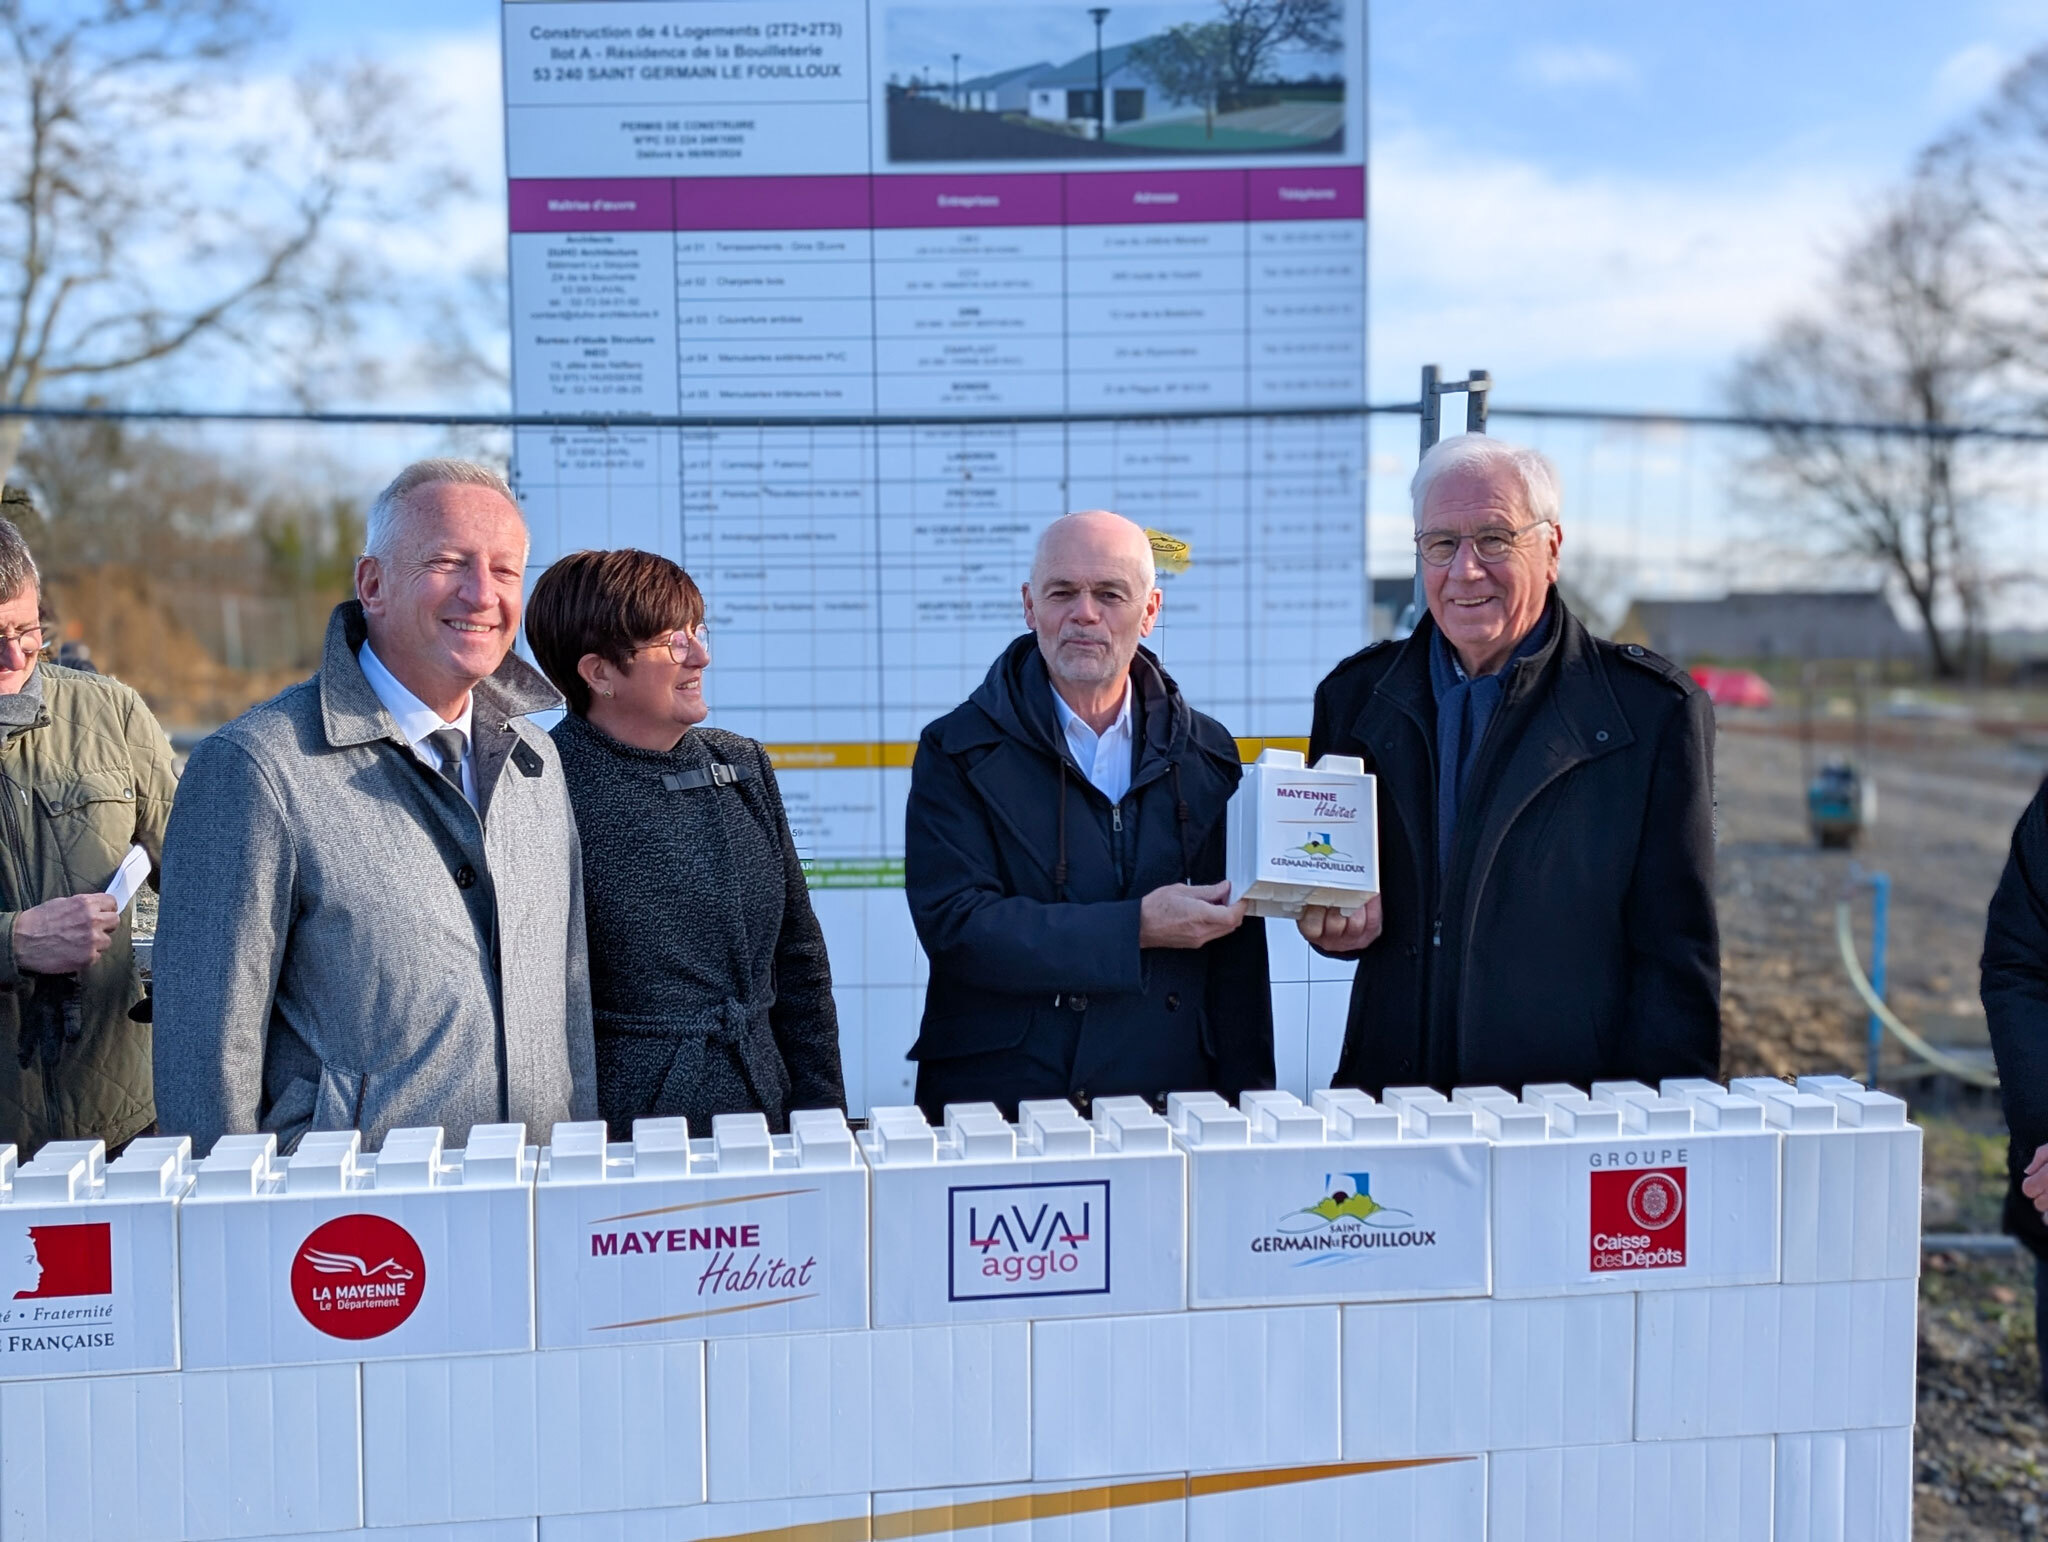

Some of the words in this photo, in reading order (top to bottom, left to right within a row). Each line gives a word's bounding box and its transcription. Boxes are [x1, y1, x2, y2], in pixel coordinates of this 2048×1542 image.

[530, 25, 633, 41] Construction
[636, 25, 655, 39] de
[659, 25, 671, 38] 4
[673, 24, 762, 42] Logements
[765, 22, 843, 39] (2T2+2T3)
[577, 46, 592, 60] A
[606, 43, 687, 60] Résidence
[691, 44, 712, 58] de
[715, 43, 730, 58] la
[734, 43, 822, 58] Bouilleterie
[533, 67, 552, 82] 53
[555, 67, 583, 82] 240
[587, 66, 636, 81] SAINT
[640, 66, 717, 80] GERMAIN
[722, 65, 743, 79] LE
[747, 64, 841, 79] FOUILLOUX
[620, 120, 662, 131] PERMIS
[666, 120, 680, 131] DE
[684, 120, 755, 131] CONSTRUIRE
[1277, 787, 1337, 802] MAYENNE
[1313, 801, 1357, 819] Habitat
[1271, 856, 1313, 869] GERMAIN
[1316, 860, 1365, 874] FOUILLOUX
[1589, 1149, 1689, 1168] GROUPE
[1330, 1223, 1361, 1234] SAINT
[591, 1224, 760, 1257] MAYENNE
[1251, 1236, 1333, 1253] GERMAIN
[1342, 1231, 1437, 1250] FOUILLOUX
[1593, 1231, 1650, 1252] Caisse
[696, 1250, 817, 1297] Habitat
[981, 1250, 1078, 1282] agglo
[312, 1287, 332, 1301] LA
[335, 1282, 406, 1299] MAYENNE
[33, 1304, 113, 1321] Fraternité
[319, 1300, 332, 1311] Le
[336, 1298, 400, 1311] Département
[8, 1333, 115, 1352] FRANÇAISE
